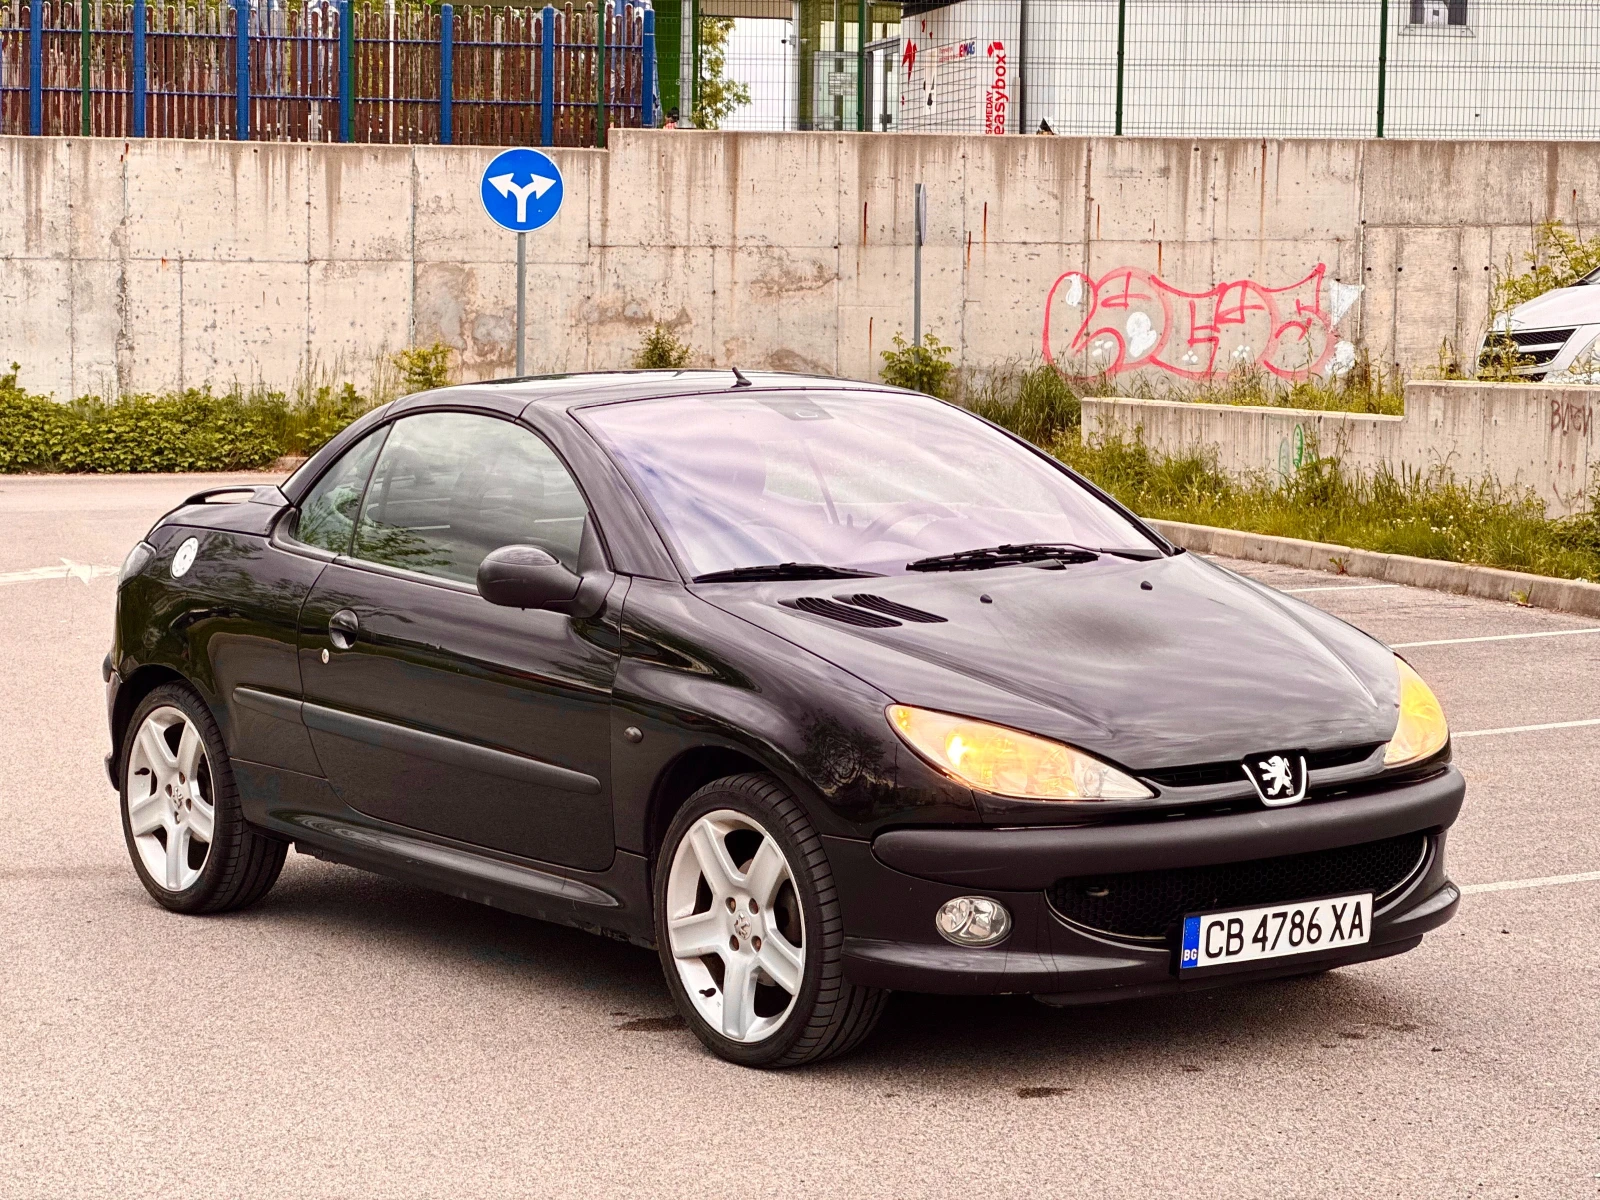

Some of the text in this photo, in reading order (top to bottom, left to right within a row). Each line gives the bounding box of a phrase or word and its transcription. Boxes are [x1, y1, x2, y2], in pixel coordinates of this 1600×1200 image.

[985, 91, 993, 134] SAMEDAY
[991, 54, 1009, 134] easybox
[1184, 948, 1198, 961] BG
[1205, 901, 1364, 959] CB 4786 XA
